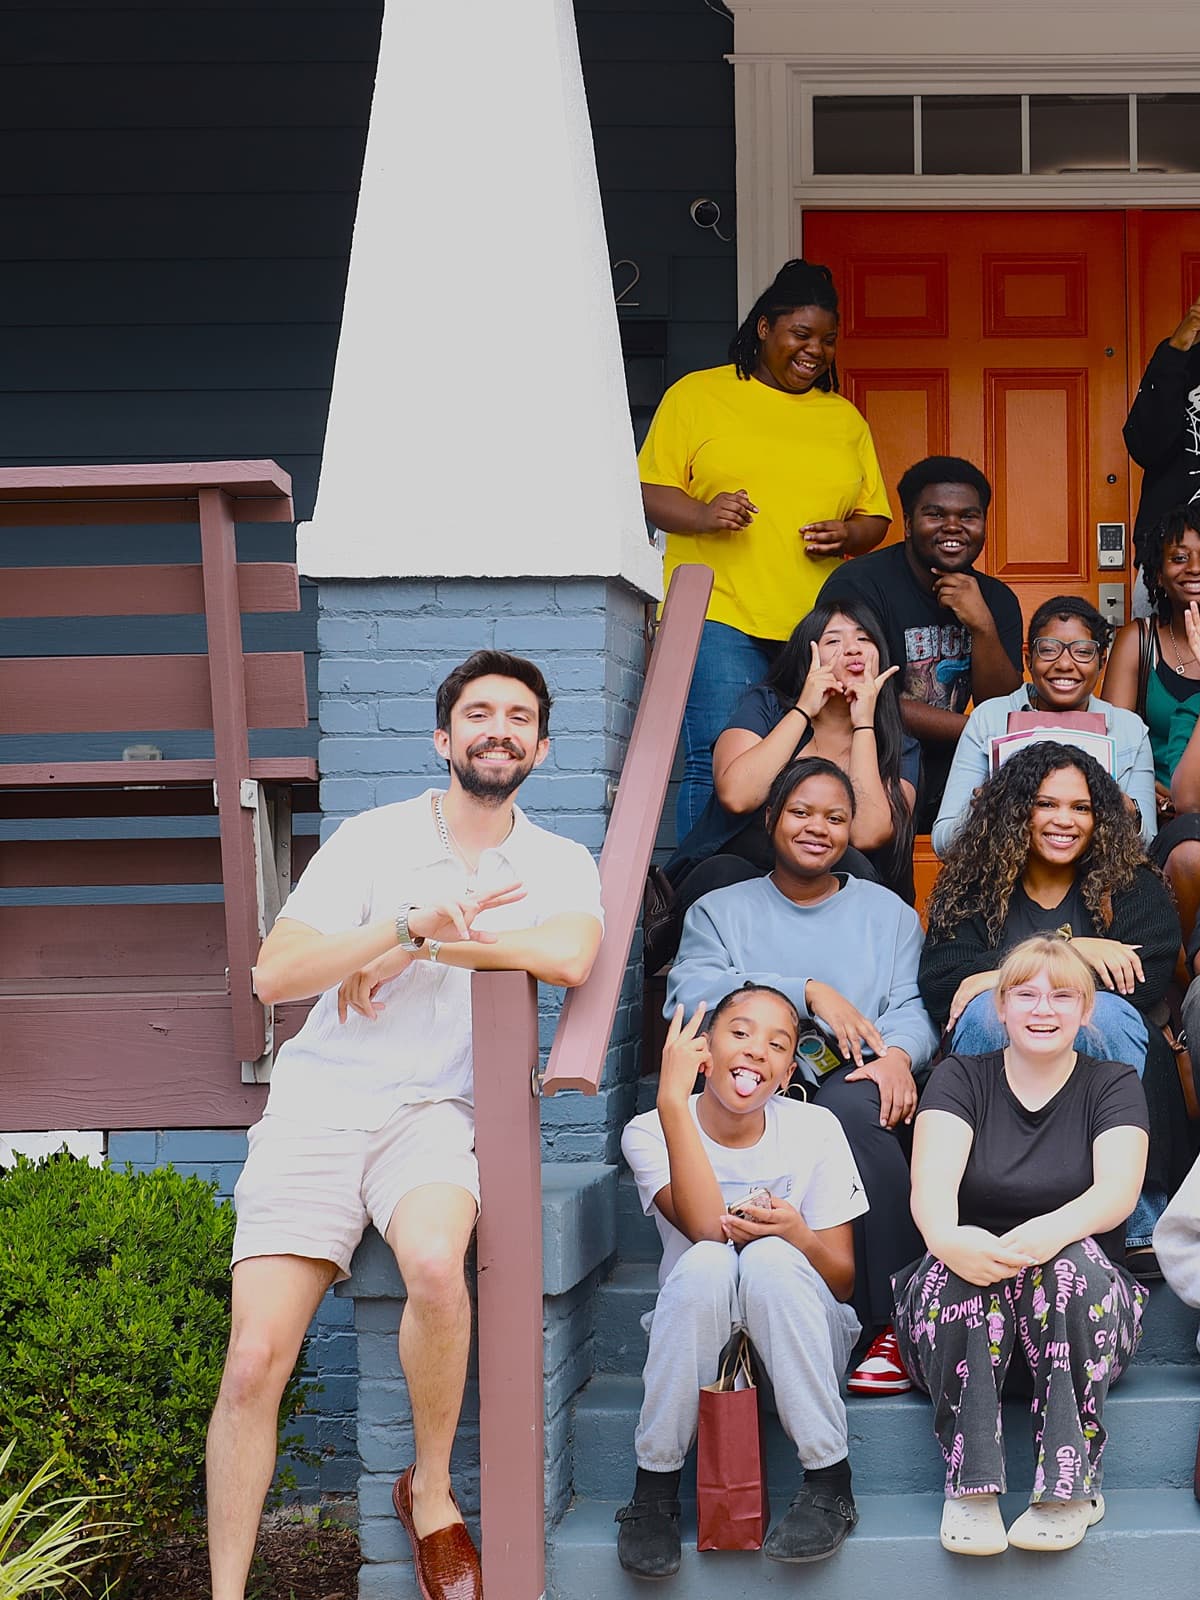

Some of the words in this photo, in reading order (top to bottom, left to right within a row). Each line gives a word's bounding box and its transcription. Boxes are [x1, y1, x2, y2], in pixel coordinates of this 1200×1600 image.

[933, 1272, 948, 1296] The
[1054, 1258, 1077, 1314] GRINCH
[1075, 1274, 1088, 1297] The
[1053, 1445, 1076, 1500] GRINCH
